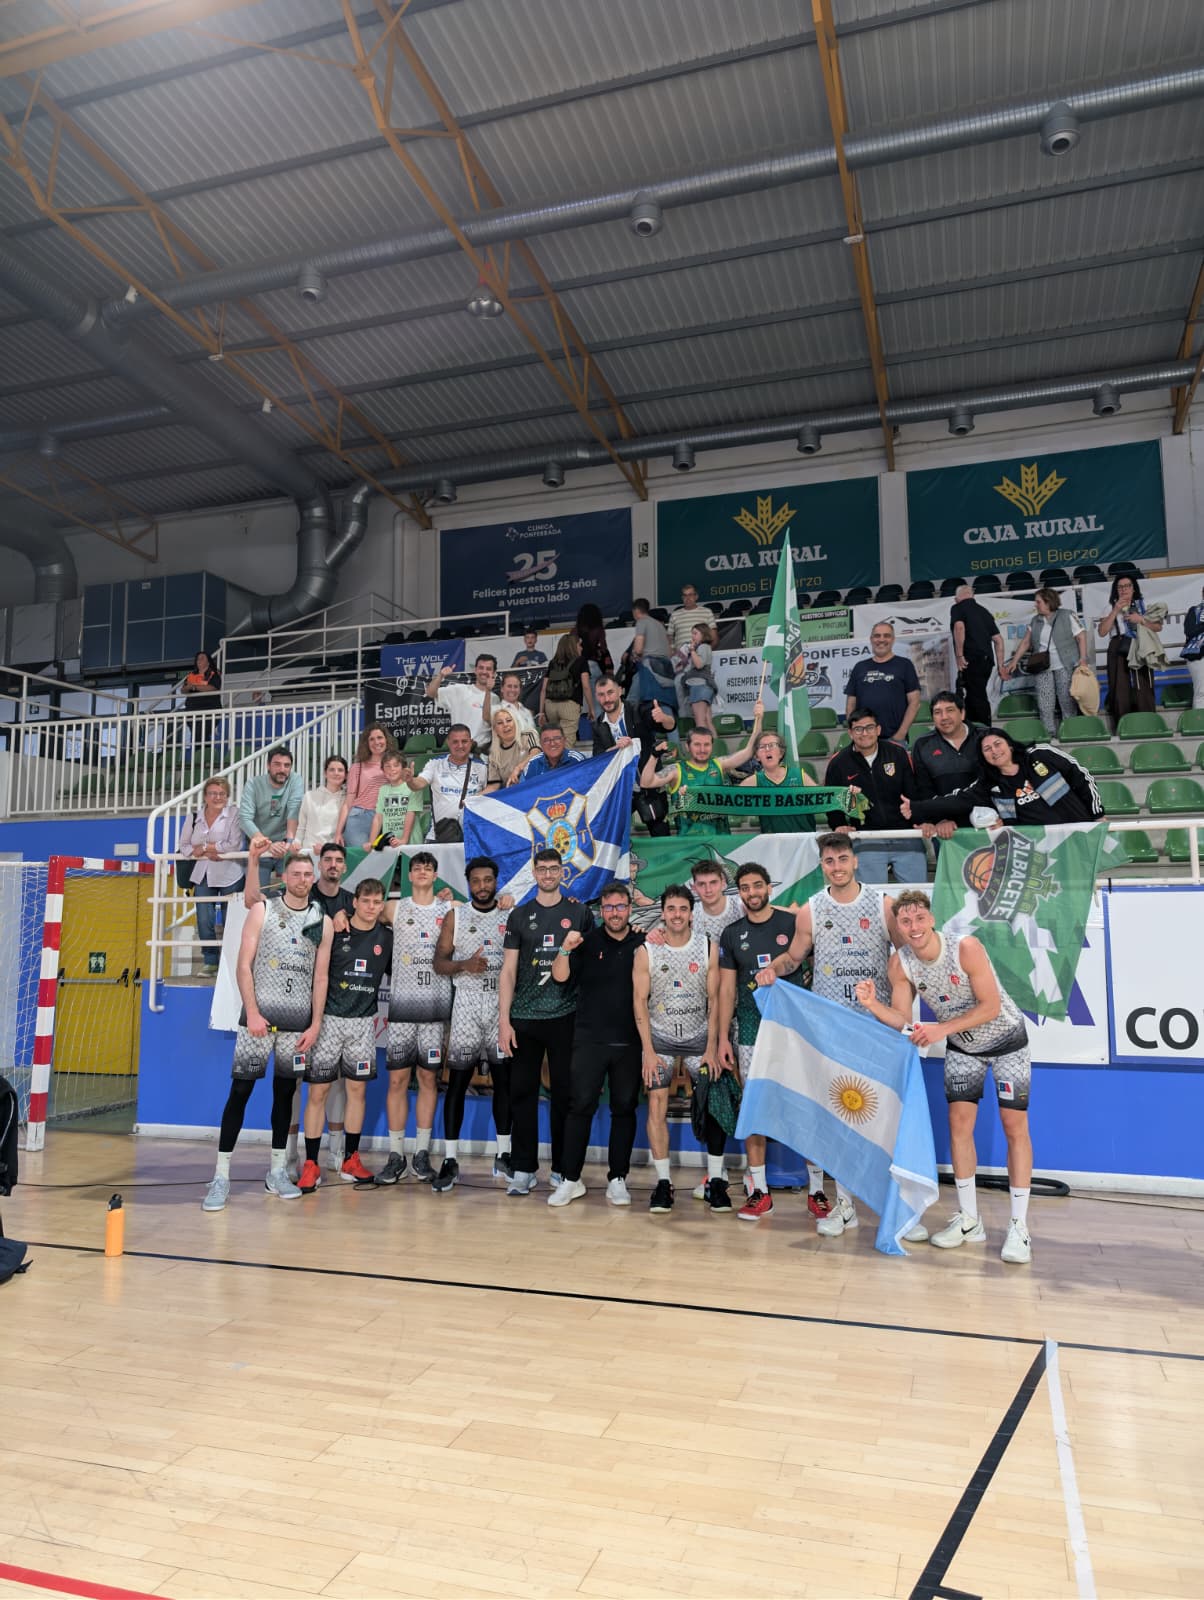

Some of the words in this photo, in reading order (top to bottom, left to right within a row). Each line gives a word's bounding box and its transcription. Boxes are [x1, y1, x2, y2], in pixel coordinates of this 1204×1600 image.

[964, 524, 1020, 544] CAJA
[1024, 515, 1104, 539] RURAL
[513, 549, 558, 582] 25
[705, 552, 754, 571] CAJA
[970, 556, 1024, 570] somos
[1028, 551, 1041, 564] El
[1047, 546, 1098, 562] Bierzo
[473, 588, 507, 599] Felices
[509, 587, 526, 598] por
[528, 584, 556, 595] estos
[558, 580, 570, 590] 25
[572, 578, 598, 589] años
[710, 582, 756, 596] somos
[760, 578, 772, 591] El
[498, 599, 504, 608] a
[507, 595, 546, 606] vuestro
[547, 592, 570, 603] lado
[395, 656, 416, 664] THE
[420, 654, 449, 662] WOLF
[720, 654, 758, 666] PEÑA
[801, 646, 871, 660] PONFESA
[697, 792, 773, 808] ALBACETE
[775, 792, 834, 808] BASKET
[992, 836, 1030, 919] ALBACETE
[286, 978, 293, 993] 5
[417, 971, 431, 986] 50
[482, 978, 496, 992] 24
[538, 971, 552, 986] 7
[674, 1024, 682, 1038] 11
[1126, 1006, 1204, 1050] CO
[956, 1031, 974, 1044] 10
